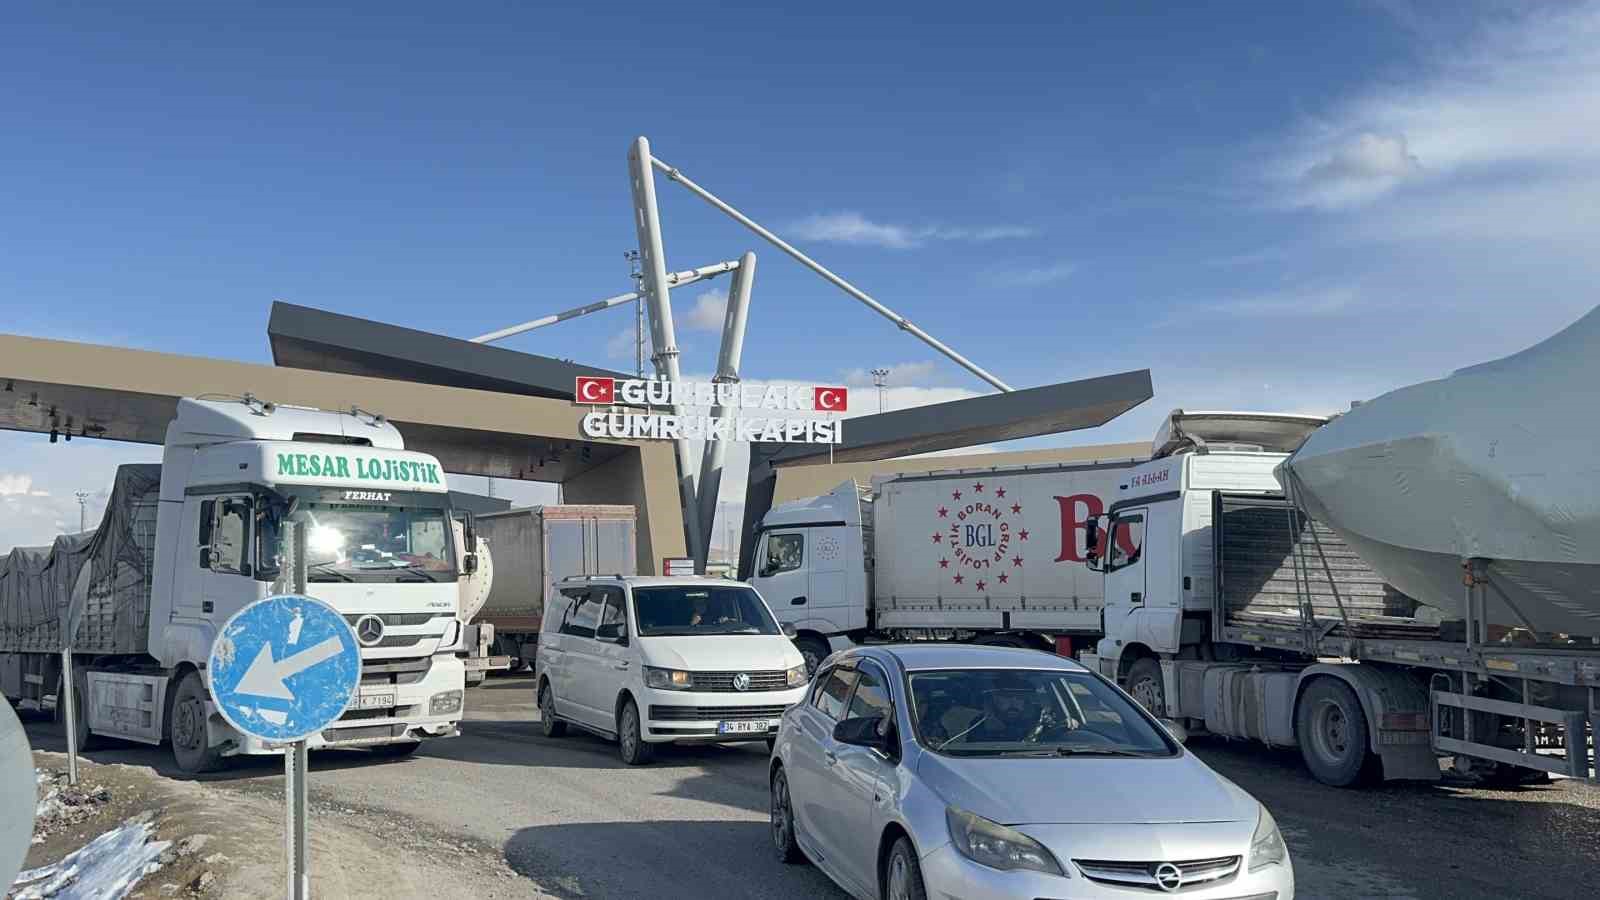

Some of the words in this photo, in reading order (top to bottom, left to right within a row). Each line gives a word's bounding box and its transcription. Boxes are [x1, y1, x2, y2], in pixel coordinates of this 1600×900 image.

[736, 415, 842, 444] KAPISI
[277, 454, 350, 478] MESAR
[344, 491, 391, 501] FERHAT
[957, 502, 1002, 521] BORAN
[993, 522, 1010, 562] GRUP
[965, 523, 996, 547] BGL
